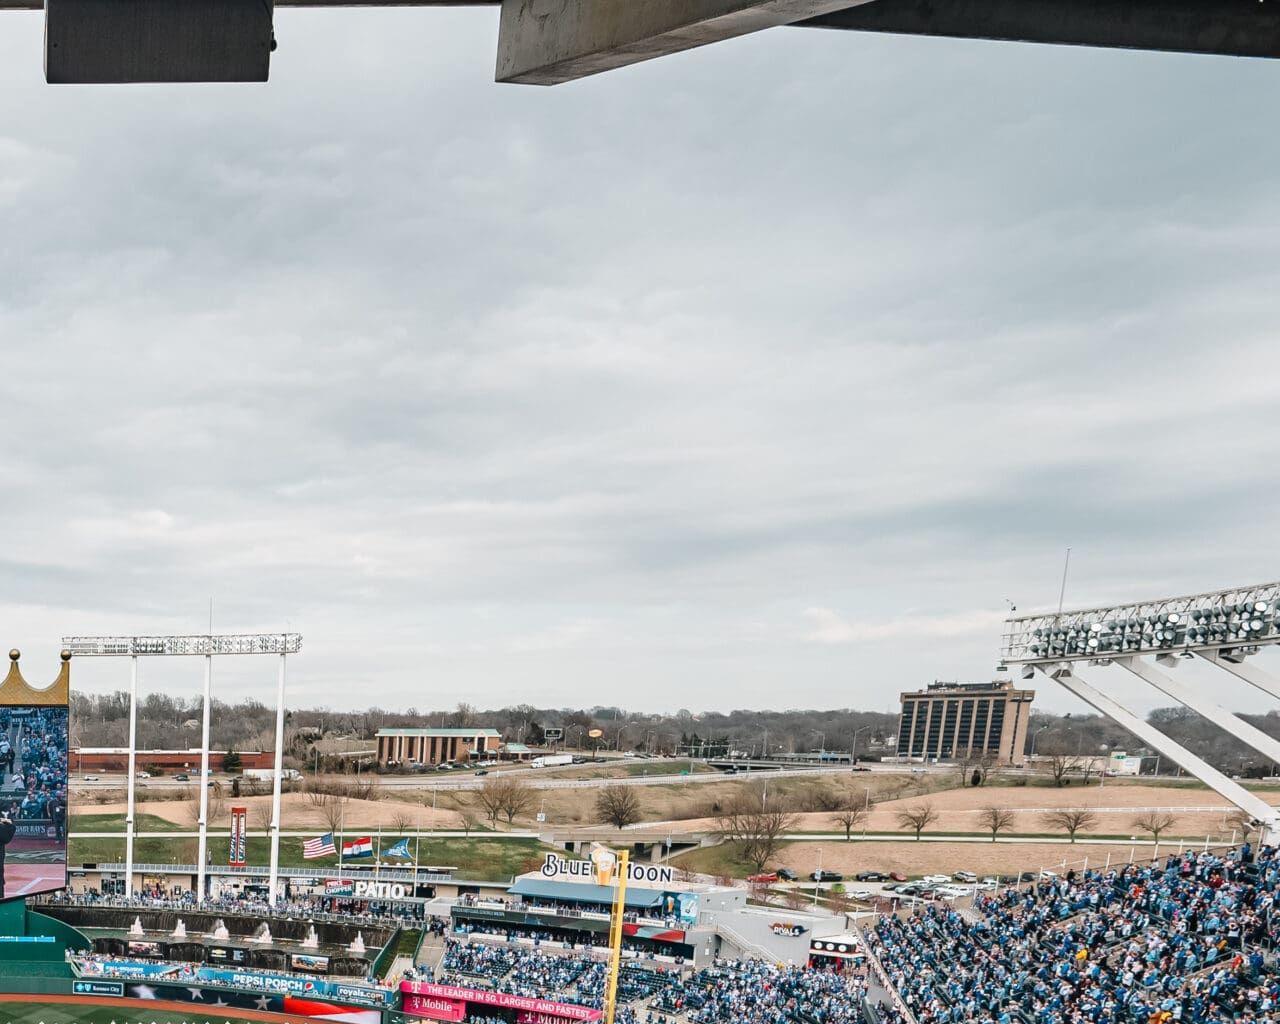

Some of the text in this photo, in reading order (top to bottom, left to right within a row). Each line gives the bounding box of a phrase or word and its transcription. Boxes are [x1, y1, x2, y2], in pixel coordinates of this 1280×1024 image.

[355, 881, 405, 899] PATIO
[773, 926, 800, 937] RIVALS
[233, 974, 302, 990] PEPSI PORCH
[339, 987, 384, 1000] royals.com
[422, 999, 452, 1012] Mobile
[427, 986, 442, 995] THE
[444, 988, 474, 1000] LEADER
[476, 992, 484, 1001] IN
[500, 995, 535, 1009] LARGEST
[536, 1001, 554, 1012] AND
[556, 1004, 591, 1019] FASTEST.
